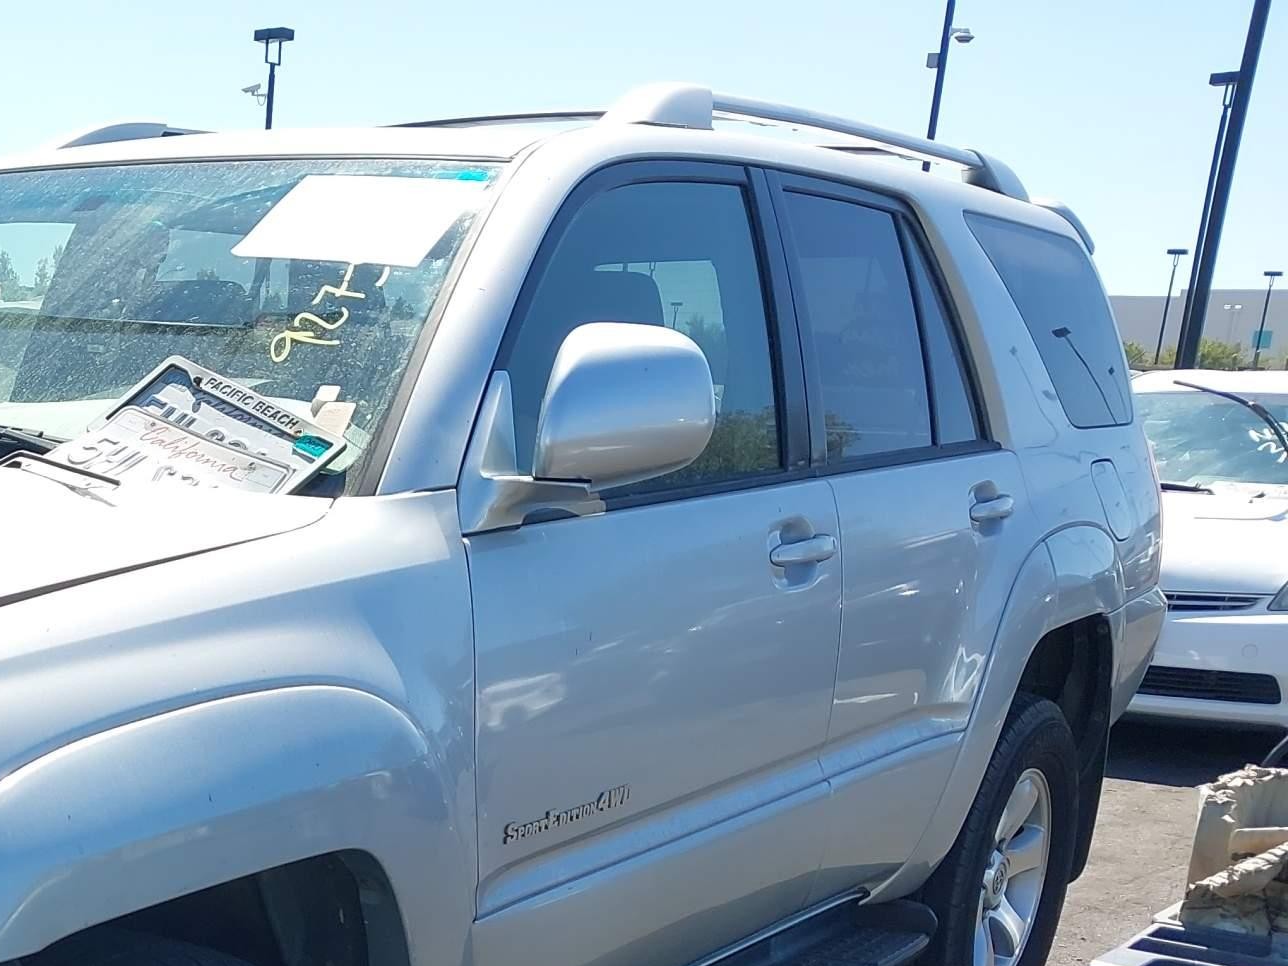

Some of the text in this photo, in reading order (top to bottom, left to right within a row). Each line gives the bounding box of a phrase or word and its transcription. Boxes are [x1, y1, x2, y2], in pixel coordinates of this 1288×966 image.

[204, 376, 253, 406] PACIFIC
[252, 401, 300, 430] BEACH
[140, 427, 244, 482] California
